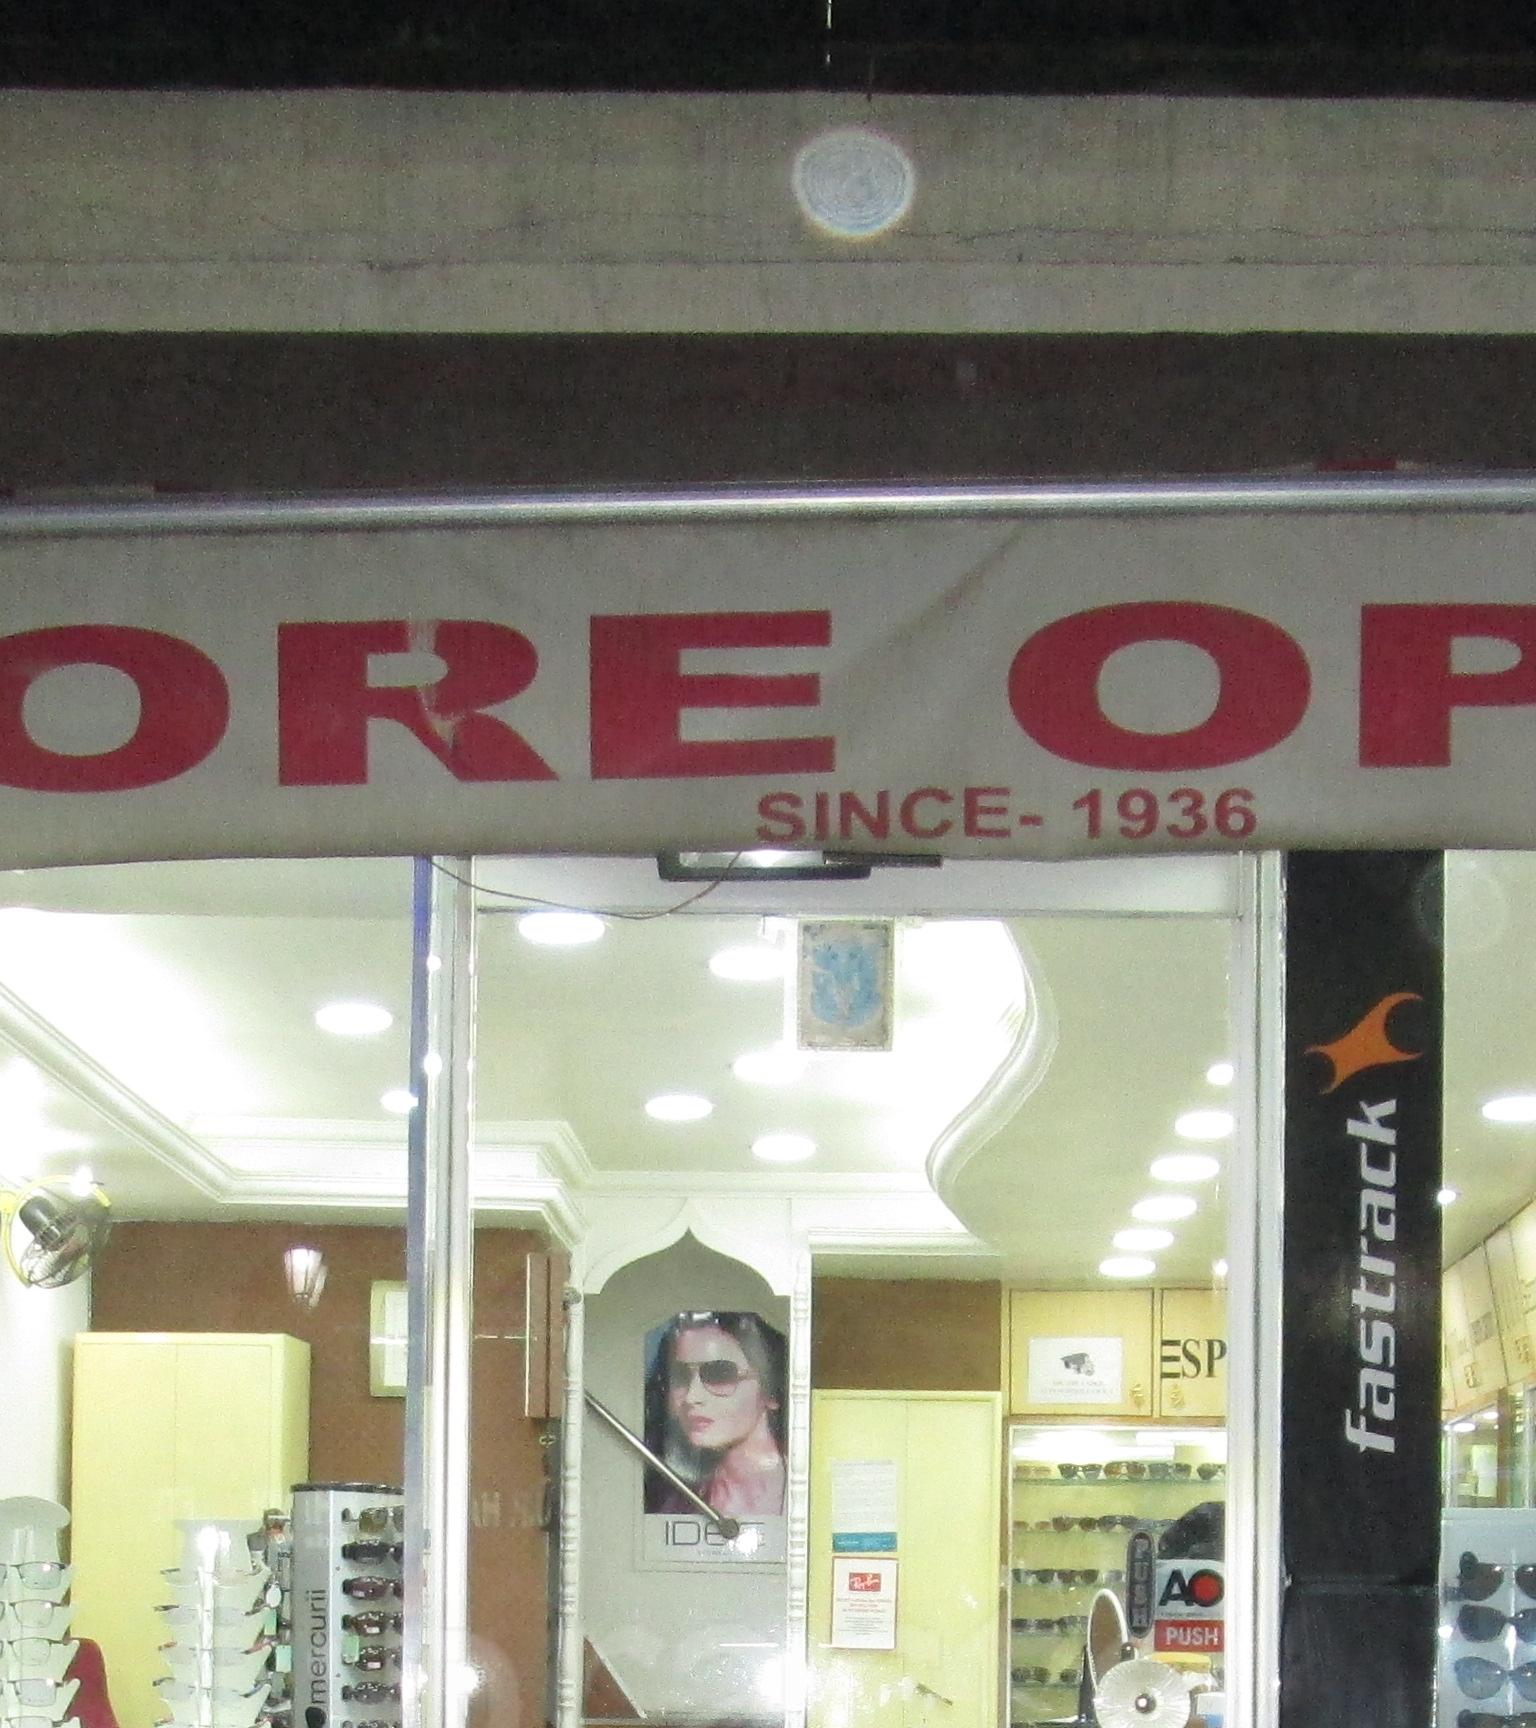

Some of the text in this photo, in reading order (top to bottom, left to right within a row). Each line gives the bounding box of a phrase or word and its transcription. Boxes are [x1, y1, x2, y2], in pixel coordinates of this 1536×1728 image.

[755, 786, 1258, 842] SINCE- 1936
[1344, 1098, 1397, 1454] fastrack
[305, 1588, 327, 1705] mercurii
[1165, 1626, 1219, 1646] PUSH
